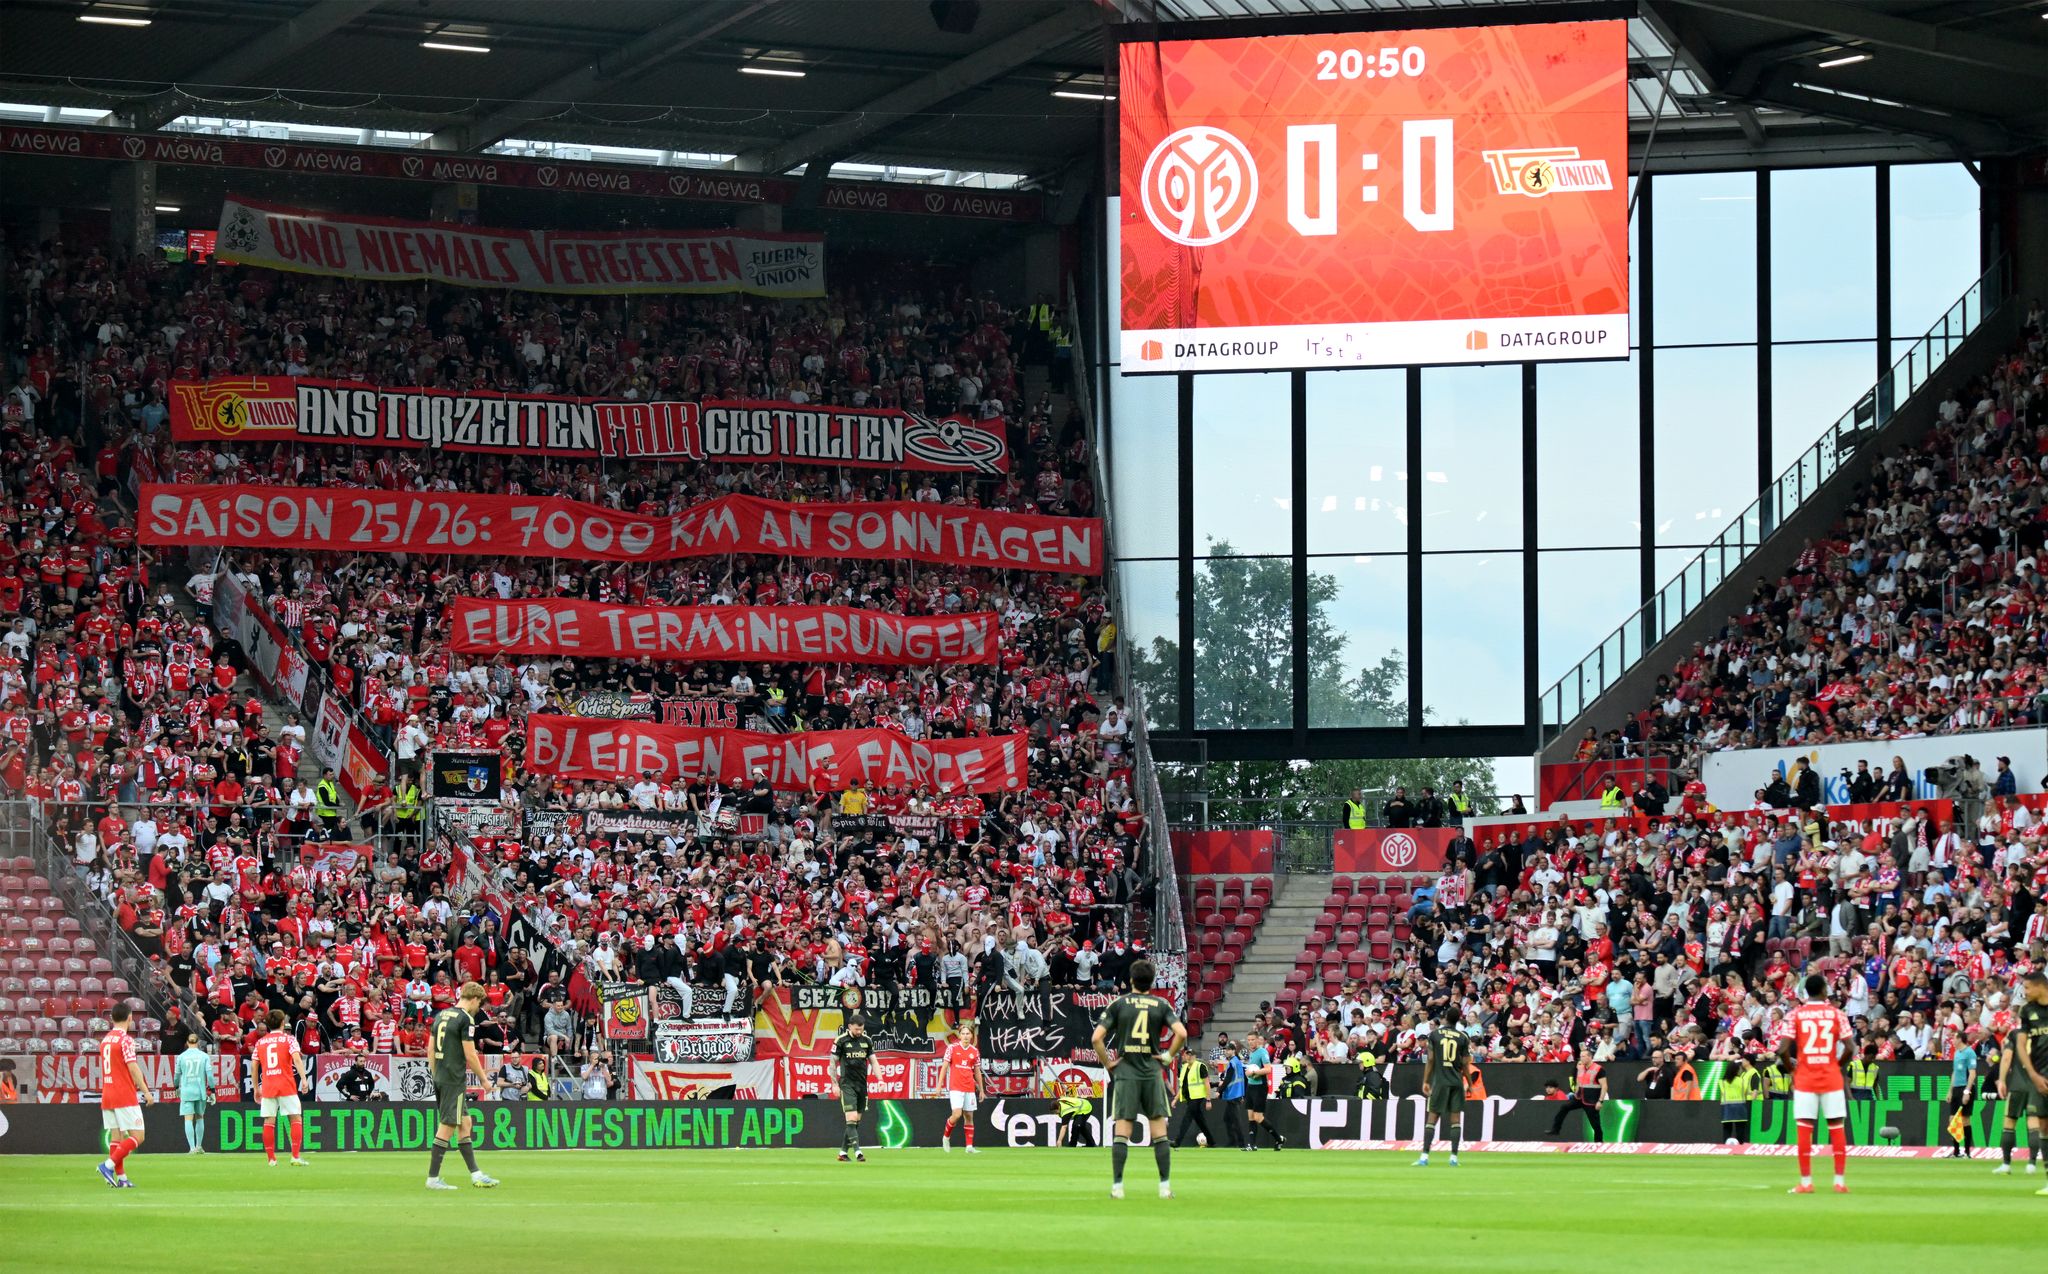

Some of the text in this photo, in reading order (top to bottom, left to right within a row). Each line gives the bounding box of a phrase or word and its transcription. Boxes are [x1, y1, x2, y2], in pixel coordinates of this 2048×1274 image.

[1317, 46, 1426, 81] 20:50
[1557, 164, 1607, 188] UNION
[267, 215, 346, 268] UND
[355, 225, 522, 283] NIEMALS
[528, 231, 743, 286] VERGESSEN
[755, 268, 810, 287] UNION
[1174, 339, 1280, 359] DATAGROUP
[1500, 329, 1608, 349] DATAGROUP
[250, 400, 297, 427] UNION
[595, 401, 706, 461] FAIR
[705, 406, 905, 462] GESTALTEN
[351, 498, 492, 546] 25/26:
[511, 504, 655, 553] 7000
[671, 504, 742, 552] KM
[760, 511, 813, 550] AN
[827, 510, 1092, 567] SONNTAGEN
[464, 605, 580, 647] EURE
[661, 700, 738, 729] DEVILS
[857, 739, 986, 790] FARCE
[888, 815, 939, 827] UNIKAT
[436, 1020, 447, 1052] 6
[1131, 1009, 1150, 1045] 4
[1801, 1020, 1834, 1055] 23
[103, 1043, 112, 1075] 8
[266, 1043, 279, 1069] 6
[678, 1038, 734, 1058] Brigade
[1440, 1037, 1458, 1062] 10
[185, 1059, 201, 1077] 27
[794, 1062, 824, 1077] Von
[795, 1079, 820, 1093] bis
[492, 1107, 517, 1148] &
[525, 1107, 735, 1148] INVESTMENT
[740, 1107, 804, 1148] APP
